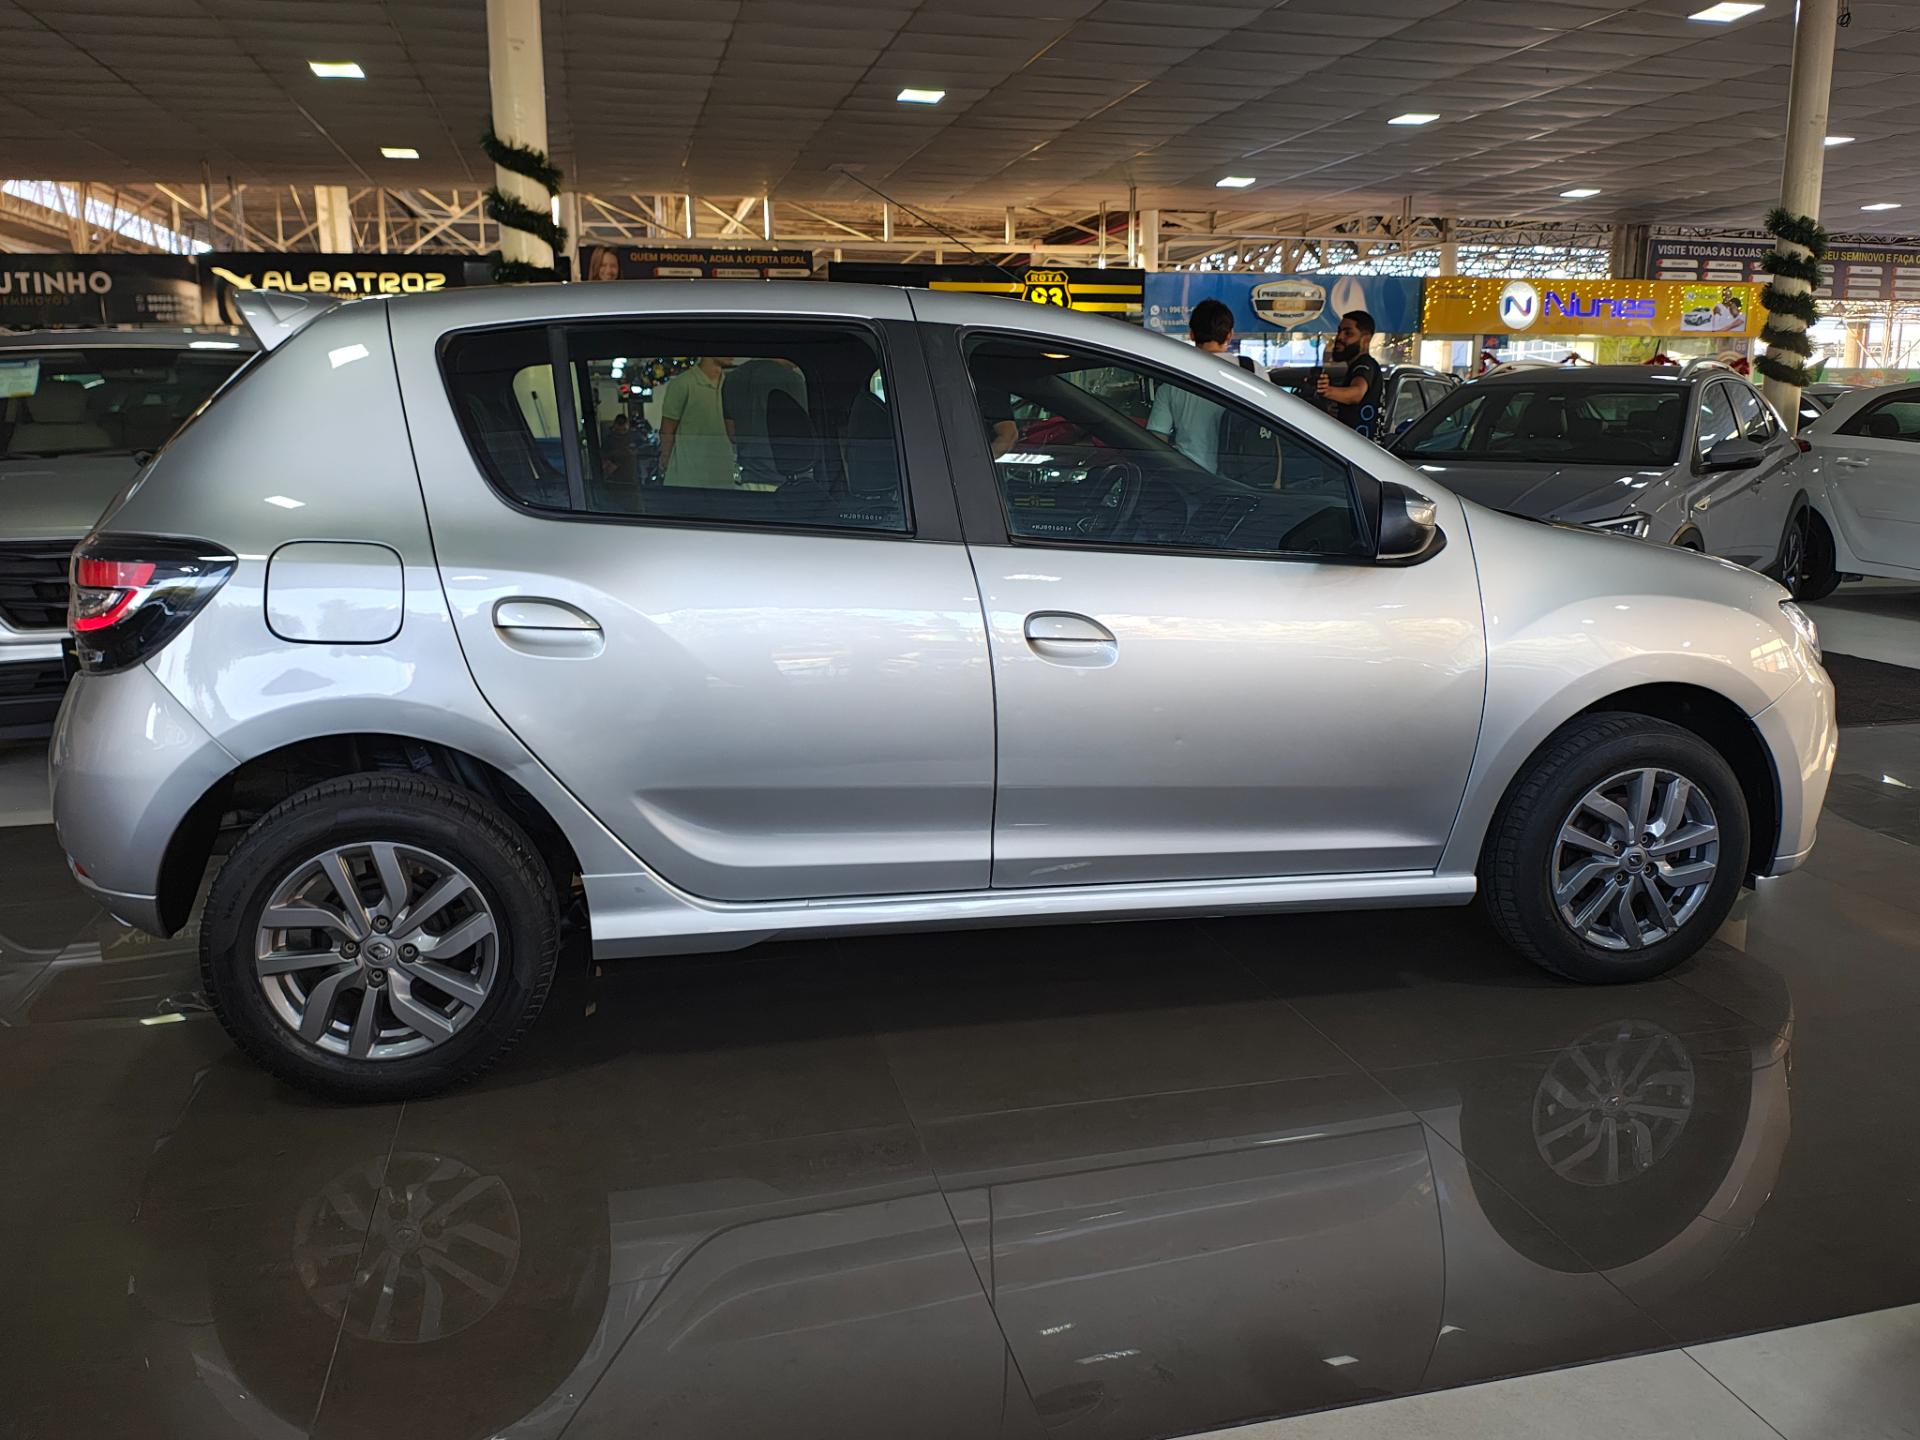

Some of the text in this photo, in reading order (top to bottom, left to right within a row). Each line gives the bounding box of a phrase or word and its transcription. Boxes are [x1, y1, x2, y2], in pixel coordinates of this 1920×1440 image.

[1657, 244, 1687, 255] VISITE
[1688, 246, 1718, 256] TODAS
[1719, 247, 1732, 257] AS
[630, 252, 807, 265] QUEM PROCURA, ACHA A OFERTA IDEAL
[1840, 251, 1885, 262] SEMINOVO
[1885, 253, 1892, 263] E
[1893, 253, 1914, 266] FAÇA
[262, 270, 446, 292] ALBATROZ
[1031, 274, 1062, 282] ROTA
[1543, 291, 1656, 319] Nunes
